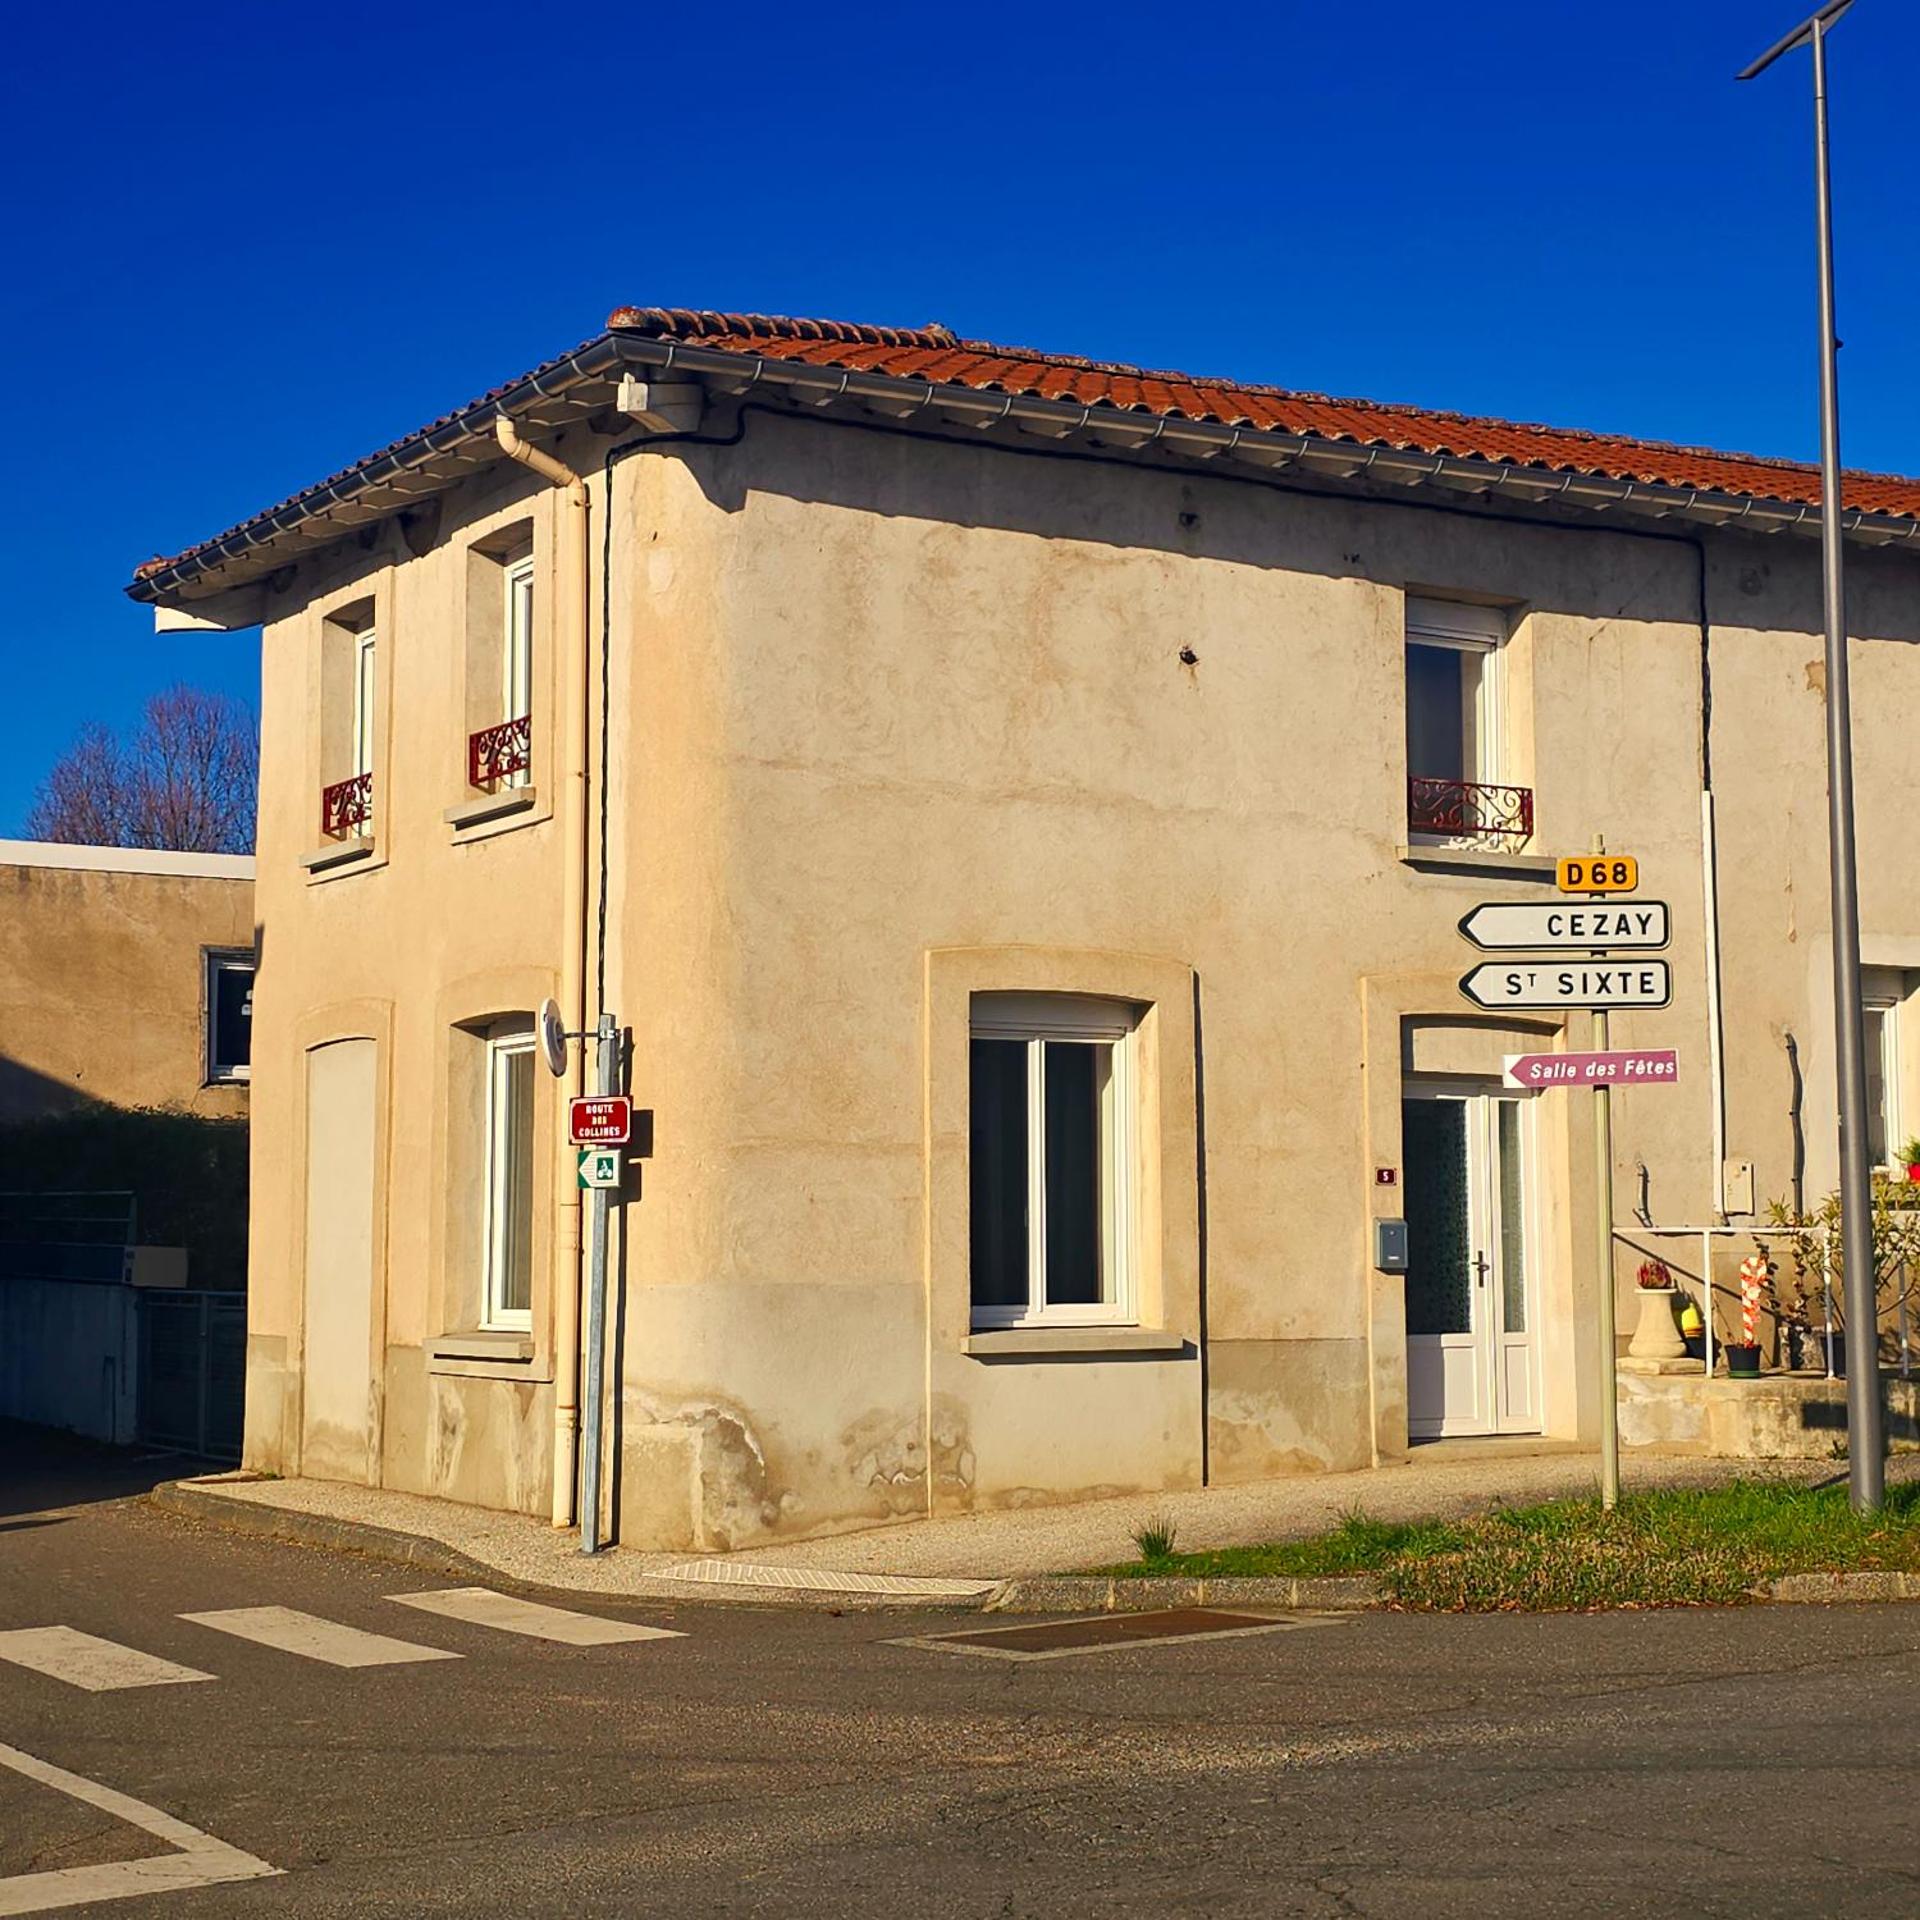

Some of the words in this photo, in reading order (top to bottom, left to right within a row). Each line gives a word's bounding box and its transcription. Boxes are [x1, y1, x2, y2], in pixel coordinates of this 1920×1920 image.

[1567, 863, 1583, 885] D
[1591, 862, 1628, 885] 68
[1547, 913, 1653, 936] CEZAY
[1506, 973, 1537, 995] ST
[1558, 972, 1655, 995] SIXTE
[1530, 1062, 1577, 1079] Salle
[1585, 1061, 1616, 1077] des
[1624, 1059, 1675, 1075] Fêtes
[585, 1104, 614, 1114] ROUTE
[578, 1126, 621, 1137] COLLINES
